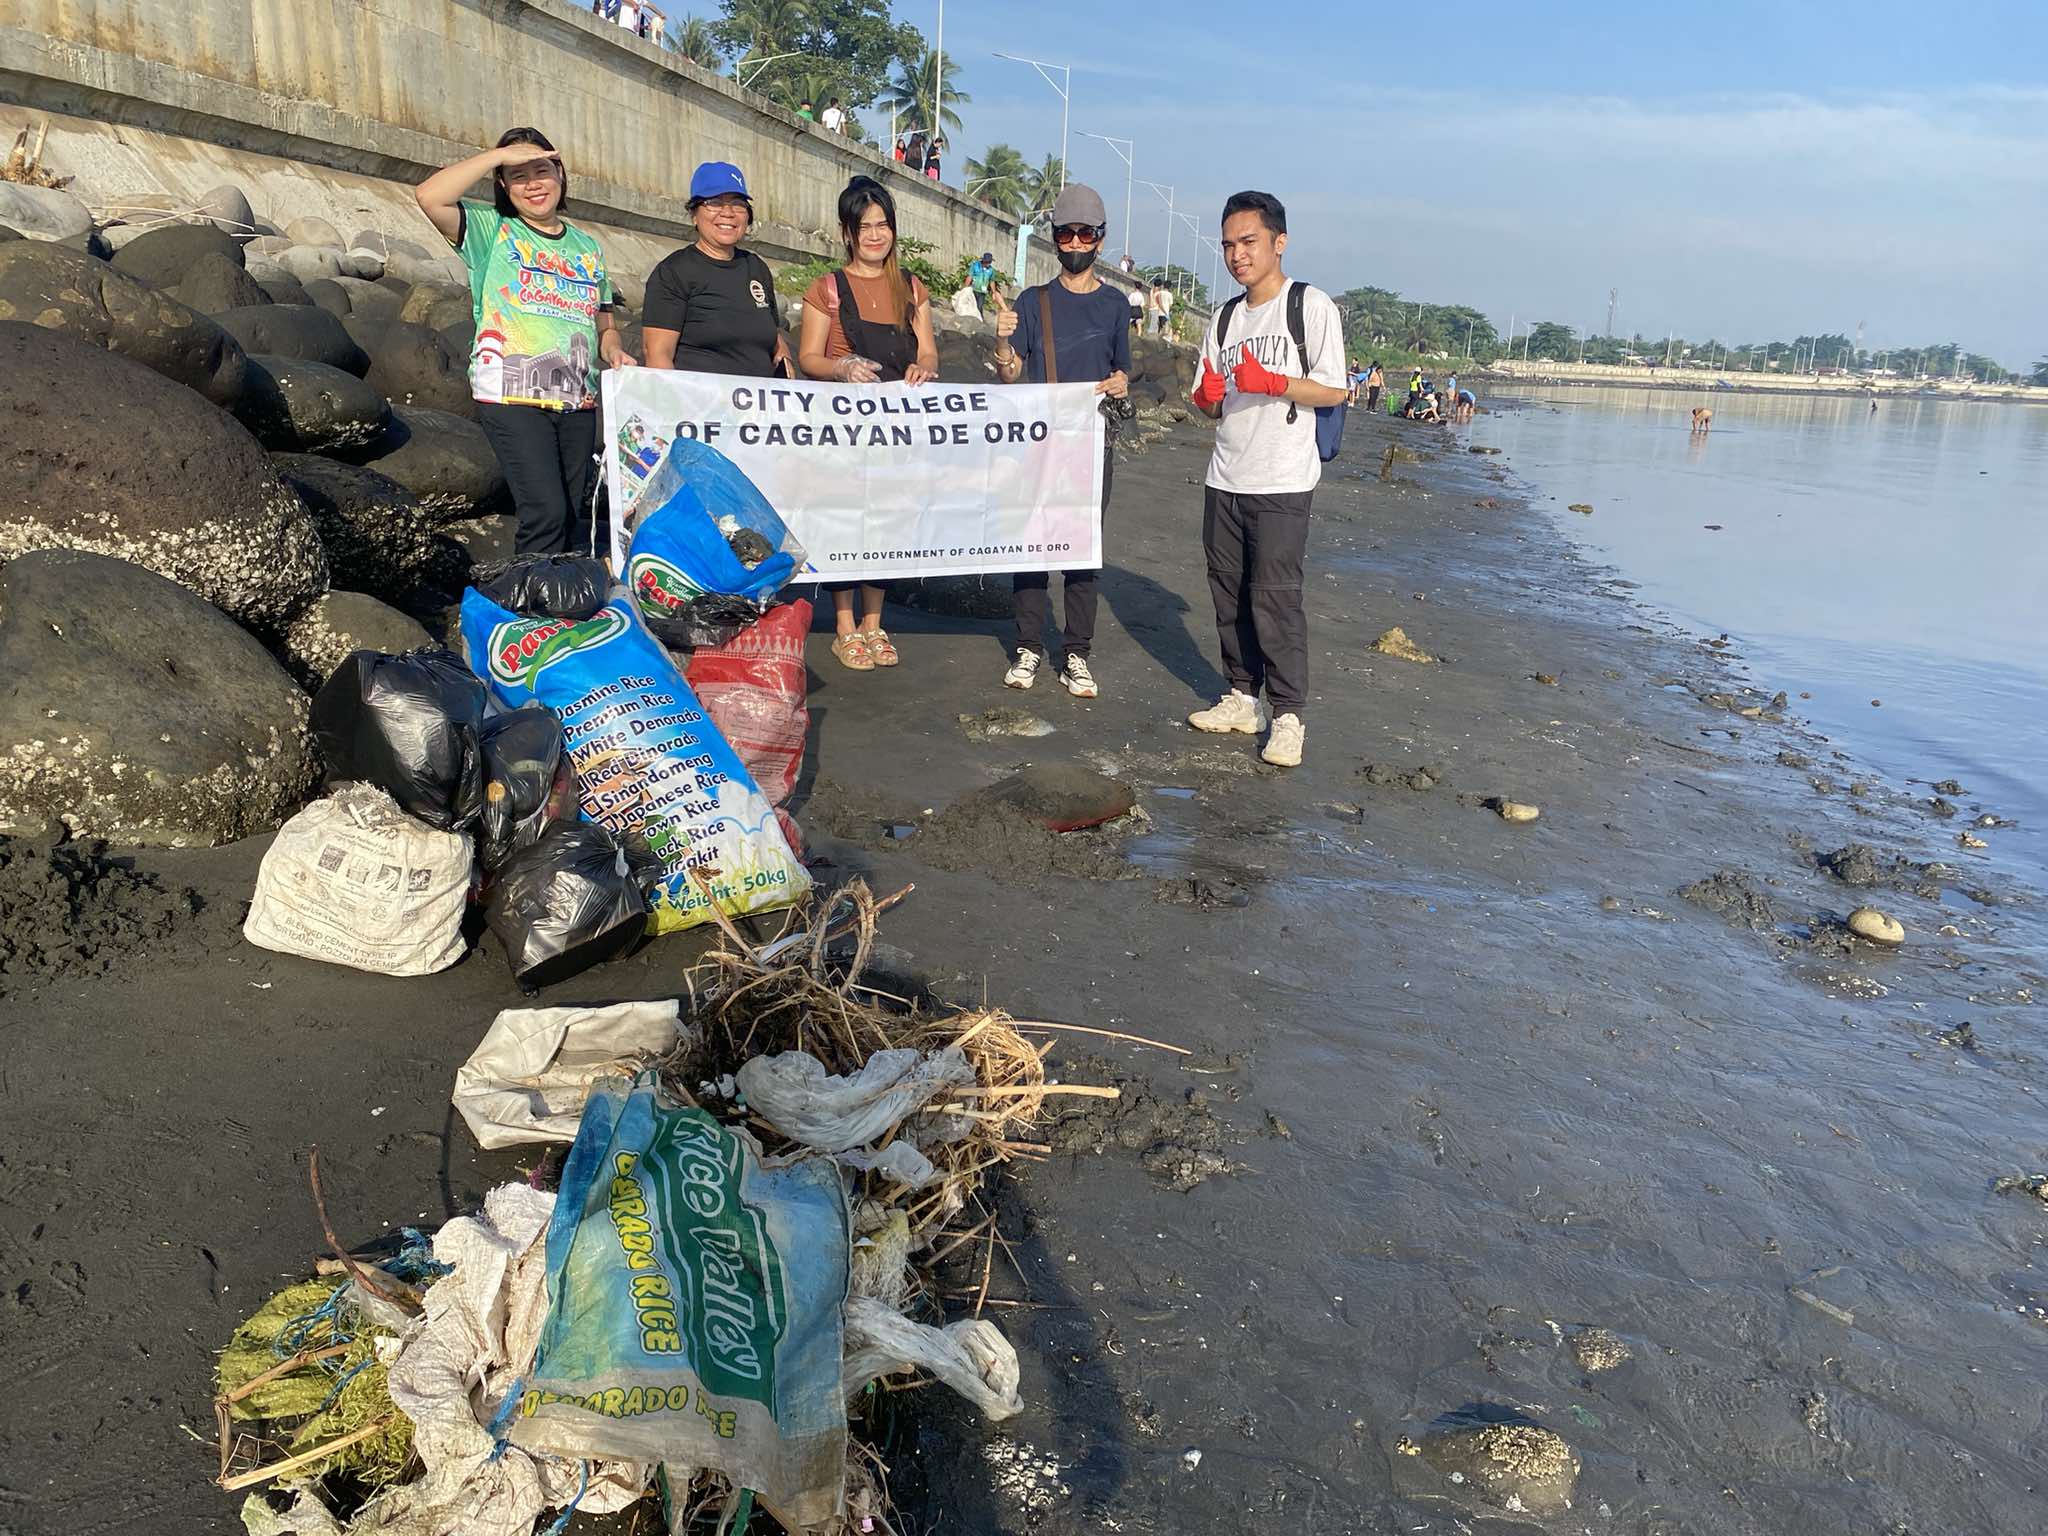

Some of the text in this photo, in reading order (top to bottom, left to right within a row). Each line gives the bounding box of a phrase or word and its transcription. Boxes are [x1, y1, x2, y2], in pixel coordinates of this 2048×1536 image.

[519, 287, 572, 311] CAGAYAN
[732, 387, 989, 416] CITY COLLEGE
[676, 420, 1049, 446] OF CAGAYAN DE ORO
[829, 542, 1071, 562] CITY GOVERNMENT OF CAGAYAN DE ORO
[557, 676, 656, 722] Jasmine Rice
[562, 692, 674, 743] Premium Rice
[574, 732, 627, 764] White
[629, 709, 702, 736] Denorado
[589, 733, 699, 788] Red Dinorado
[600, 753, 714, 809] Sinandomeng
[615, 771, 728, 828] Japanese Rice
[684, 797, 721, 817] Rice
[688, 819, 726, 843] Rice
[668, 884, 737, 910] Weight:
[744, 868, 787, 892] 50kg
[324, 934, 359, 954] CEMENT
[631, 1274, 684, 1354] RICE
[689, 1226, 762, 1380] Valley
